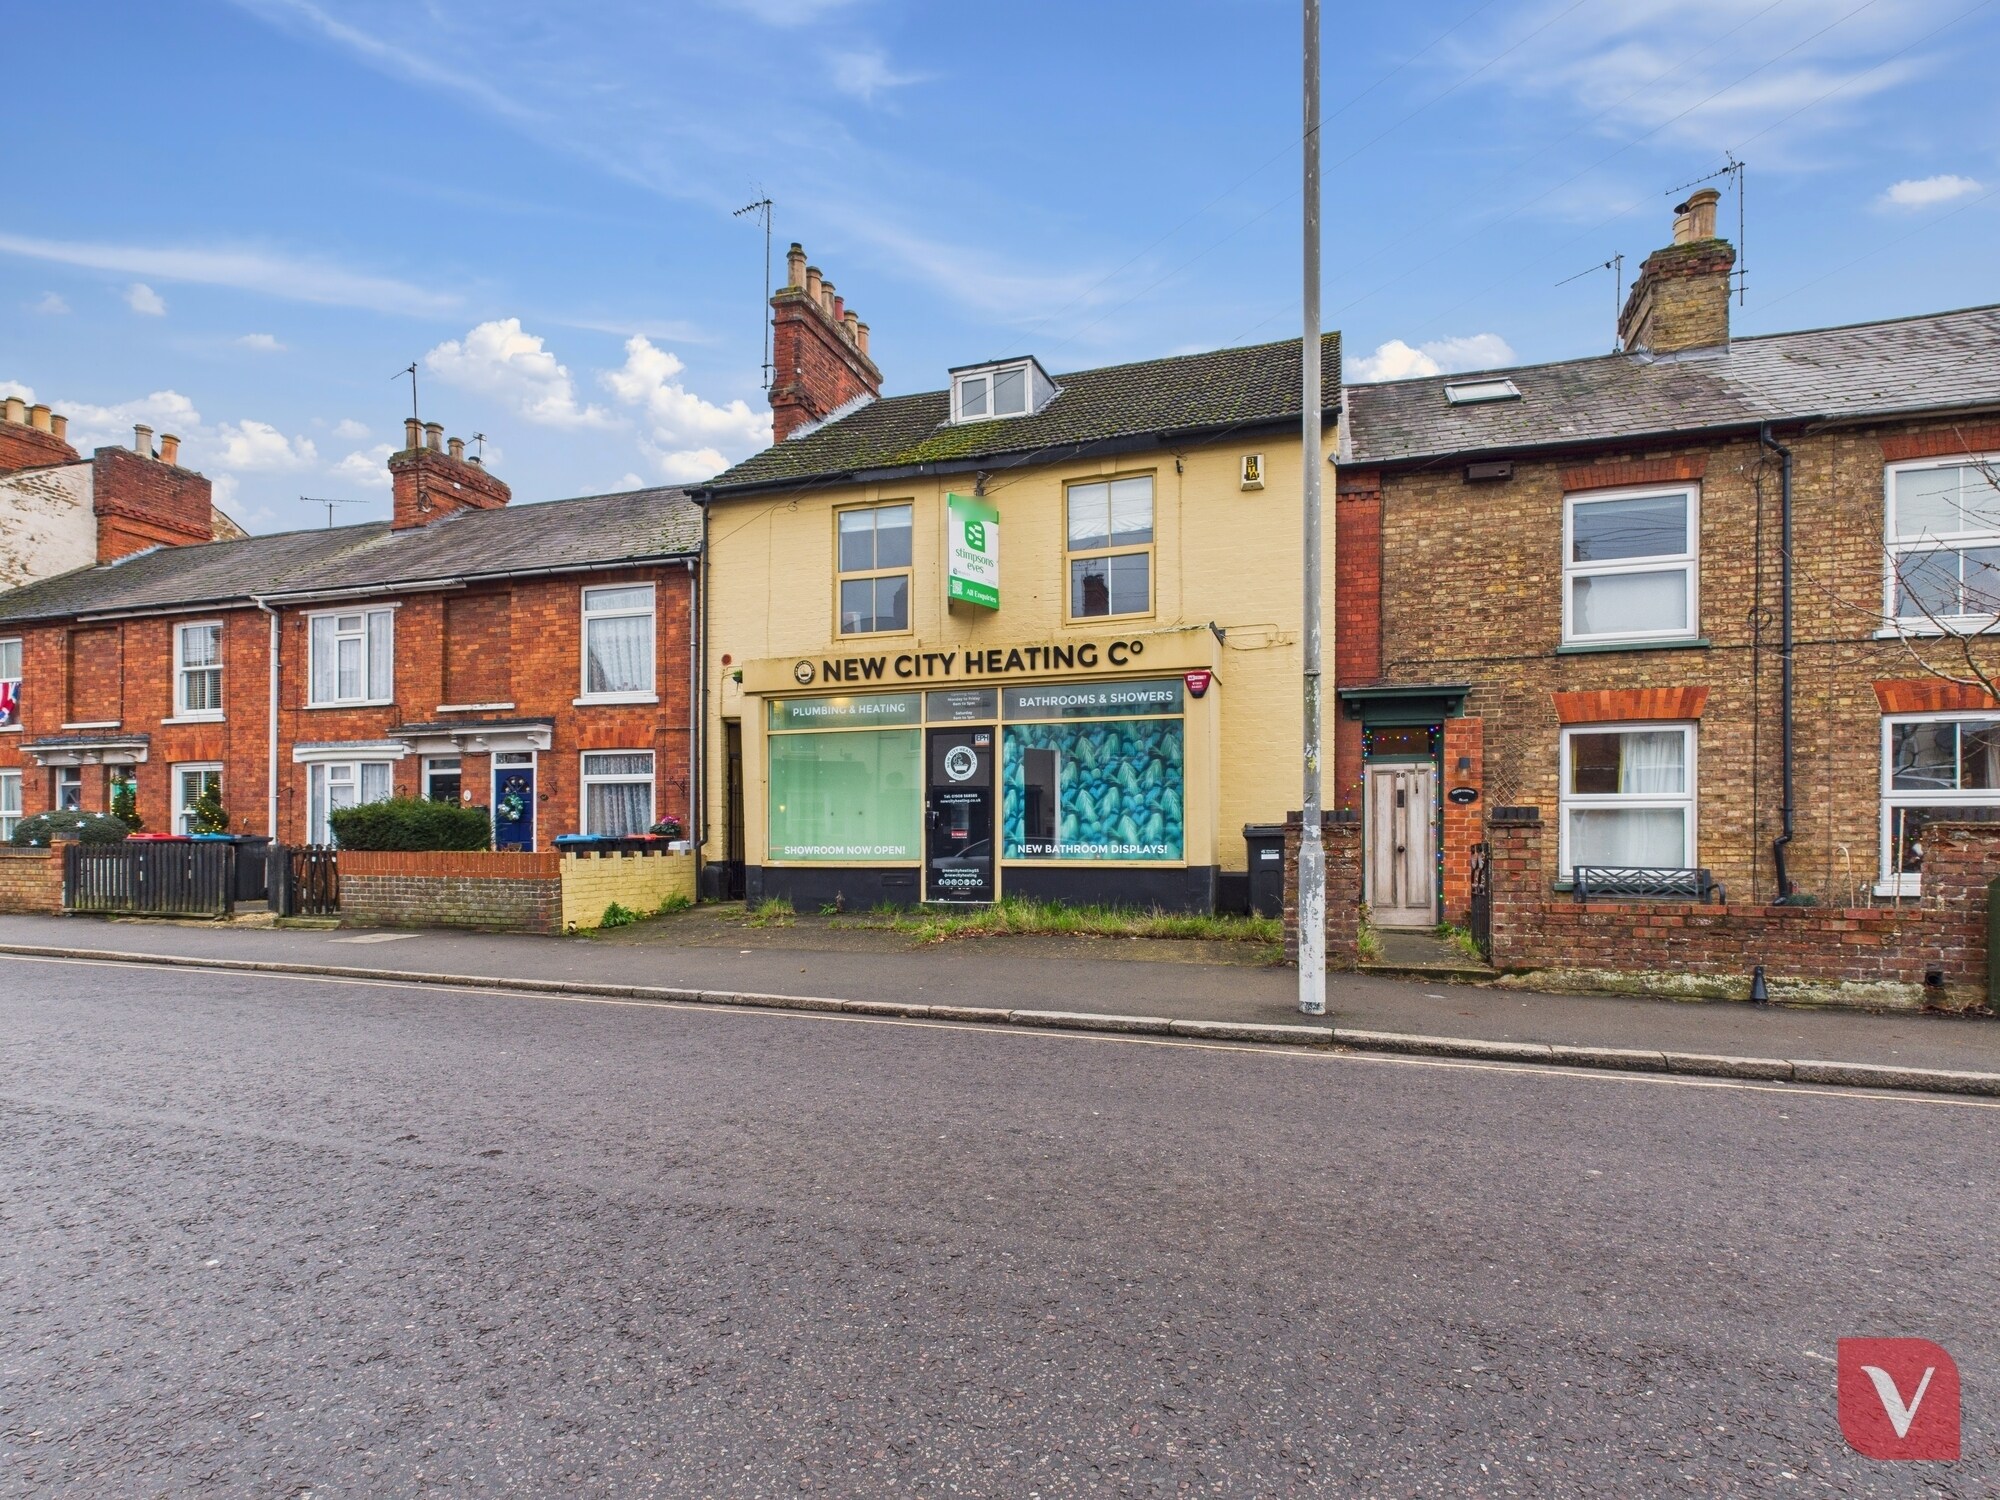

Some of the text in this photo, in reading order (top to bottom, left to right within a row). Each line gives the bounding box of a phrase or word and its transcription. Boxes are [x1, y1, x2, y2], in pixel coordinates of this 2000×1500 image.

[955, 547, 994, 568] stimpsons
[967, 561, 984, 574] eves
[823, 656, 886, 682] NEW
[894, 652, 956, 678] CITY
[965, 644, 1098, 674] HEATING
[1019, 691, 1173, 707] BATHROOMS & SHOWERS
[792, 703, 906, 717] PLUMBING & HEATING
[784, 846, 906, 855] SHOWROOM NOW OPEN!
[1017, 844, 1168, 854] NEW BATHROOM DISPLAYS!
